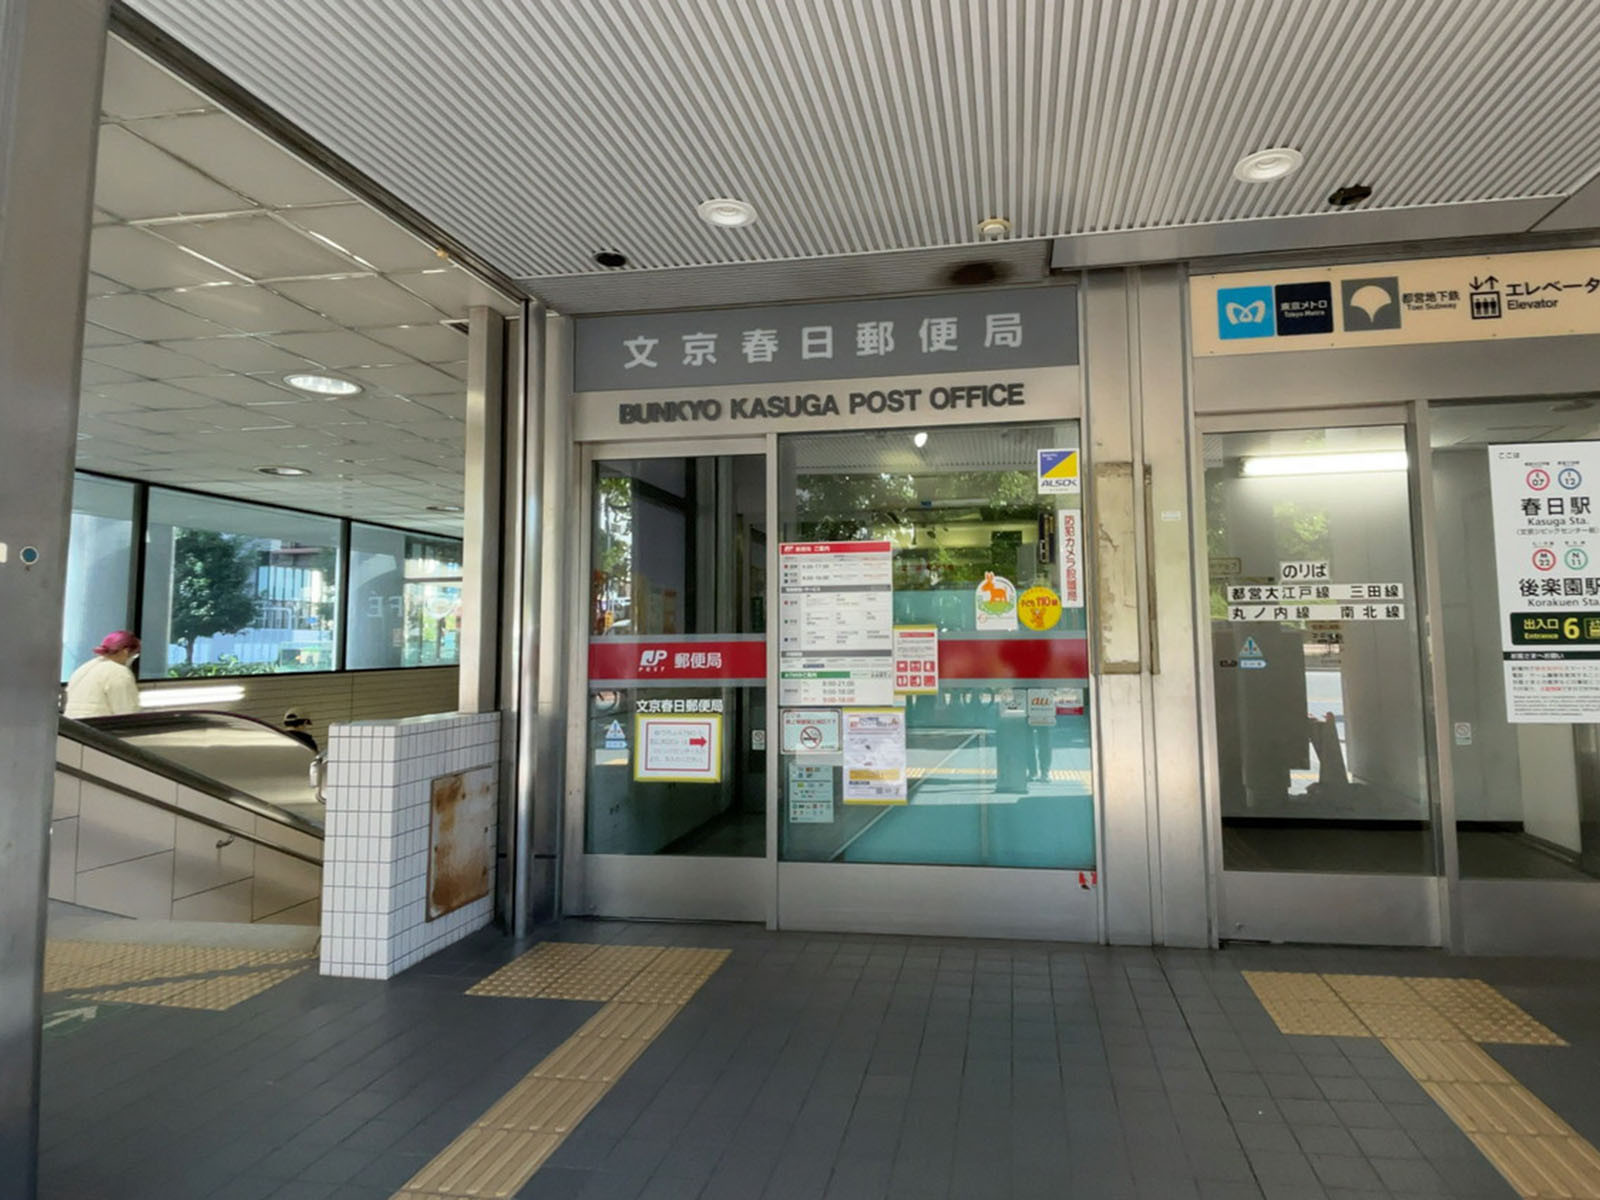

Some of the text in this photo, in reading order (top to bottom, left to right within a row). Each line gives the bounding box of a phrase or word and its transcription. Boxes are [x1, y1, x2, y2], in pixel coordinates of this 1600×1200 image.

[1507, 299, 1559, 311] Elevator
[623, 312, 1024, 370] 文京春日郵便局
[619, 383, 1025, 425] BUNKYO KASUGA POST OFFICE
[1040, 479, 1078, 487] ALSOK
[1521, 496, 1591, 516] 春日駅
[1528, 517, 1566, 527] Kasuga
[1283, 563, 1328, 579] のりば
[1232, 585, 1400, 600] 都営大江戸線 三田線
[1528, 598, 1579, 607] Korakuen
[1232, 605, 1400, 620] 丸ノ内線 南北線
[1524, 617, 1580, 639] 出入口 6
[674, 652, 722, 669] 郵便局
[636, 699, 723, 713] 文京春日郵便局
